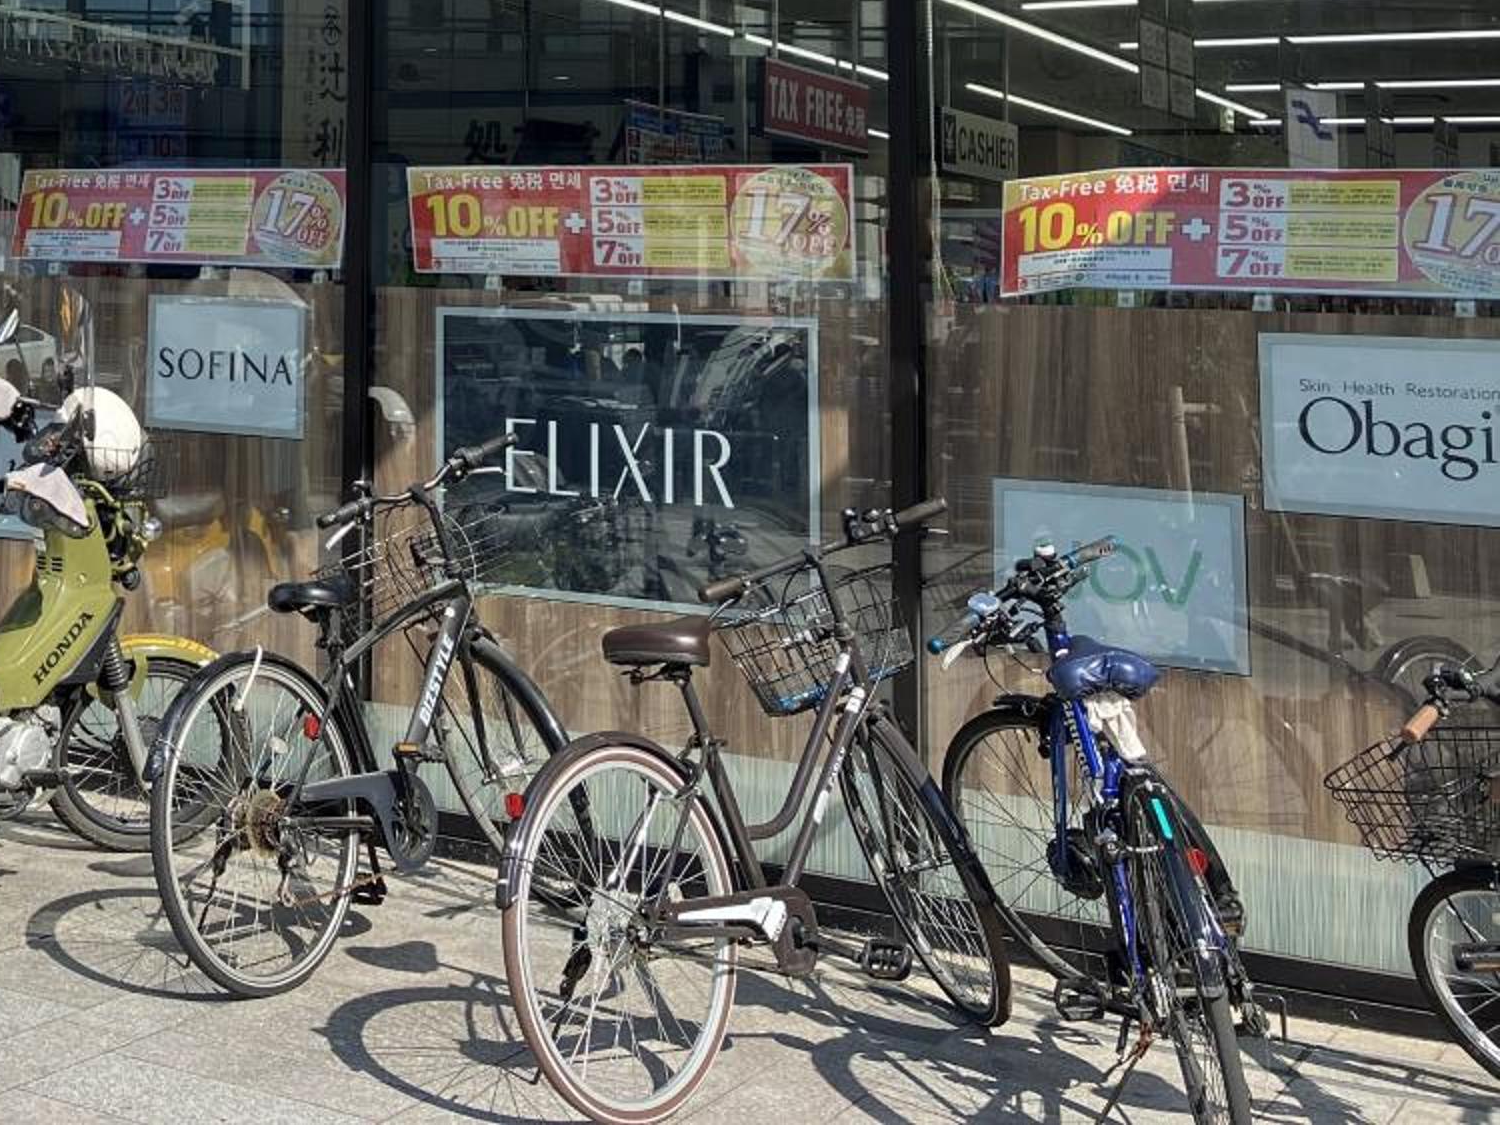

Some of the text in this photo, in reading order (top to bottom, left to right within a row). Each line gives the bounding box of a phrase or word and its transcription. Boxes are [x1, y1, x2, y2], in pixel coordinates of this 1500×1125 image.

[769, 76, 799, 123] TAX
[805, 85, 844, 133] FREE
[958, 126, 1015, 170] CASHIER
[425, 173, 504, 190] Tax-Free
[1019, 180, 1106, 201] Tax-Free
[1115, 174, 1159, 194] 免税
[158, 346, 293, 386] SOFINA
[1299, 378, 1500, 401] Skin Health Restoration
[504, 417, 735, 508] ELIXIR
[1299, 396, 1498, 481] Obagi
[1066, 541, 1204, 610] OV
[33, 612, 94, 685] HONDA
